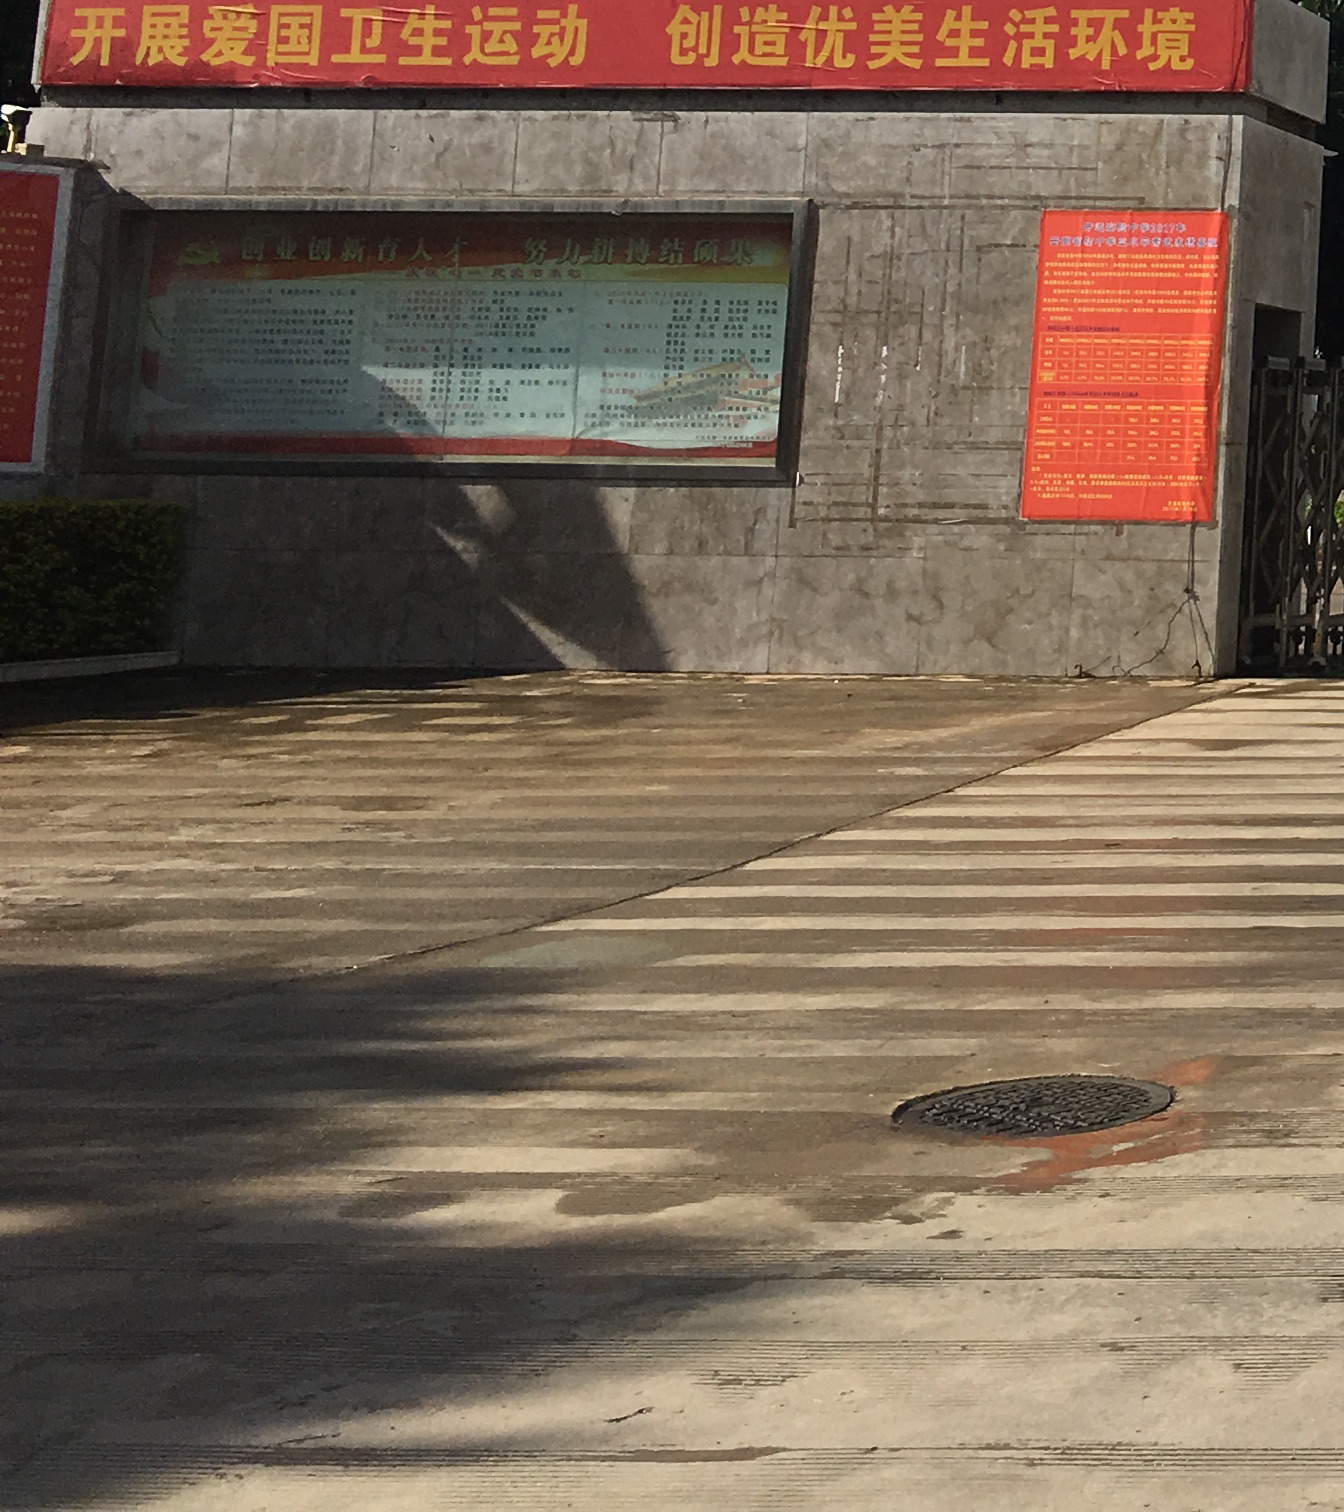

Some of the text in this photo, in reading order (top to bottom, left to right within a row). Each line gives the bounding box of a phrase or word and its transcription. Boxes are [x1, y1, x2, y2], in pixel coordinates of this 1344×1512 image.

[69, 2, 1197, 72] 开展爱国卫生运动 创造优美生活环境
[522, 237, 755, 266] 努力拼搏结硕果
